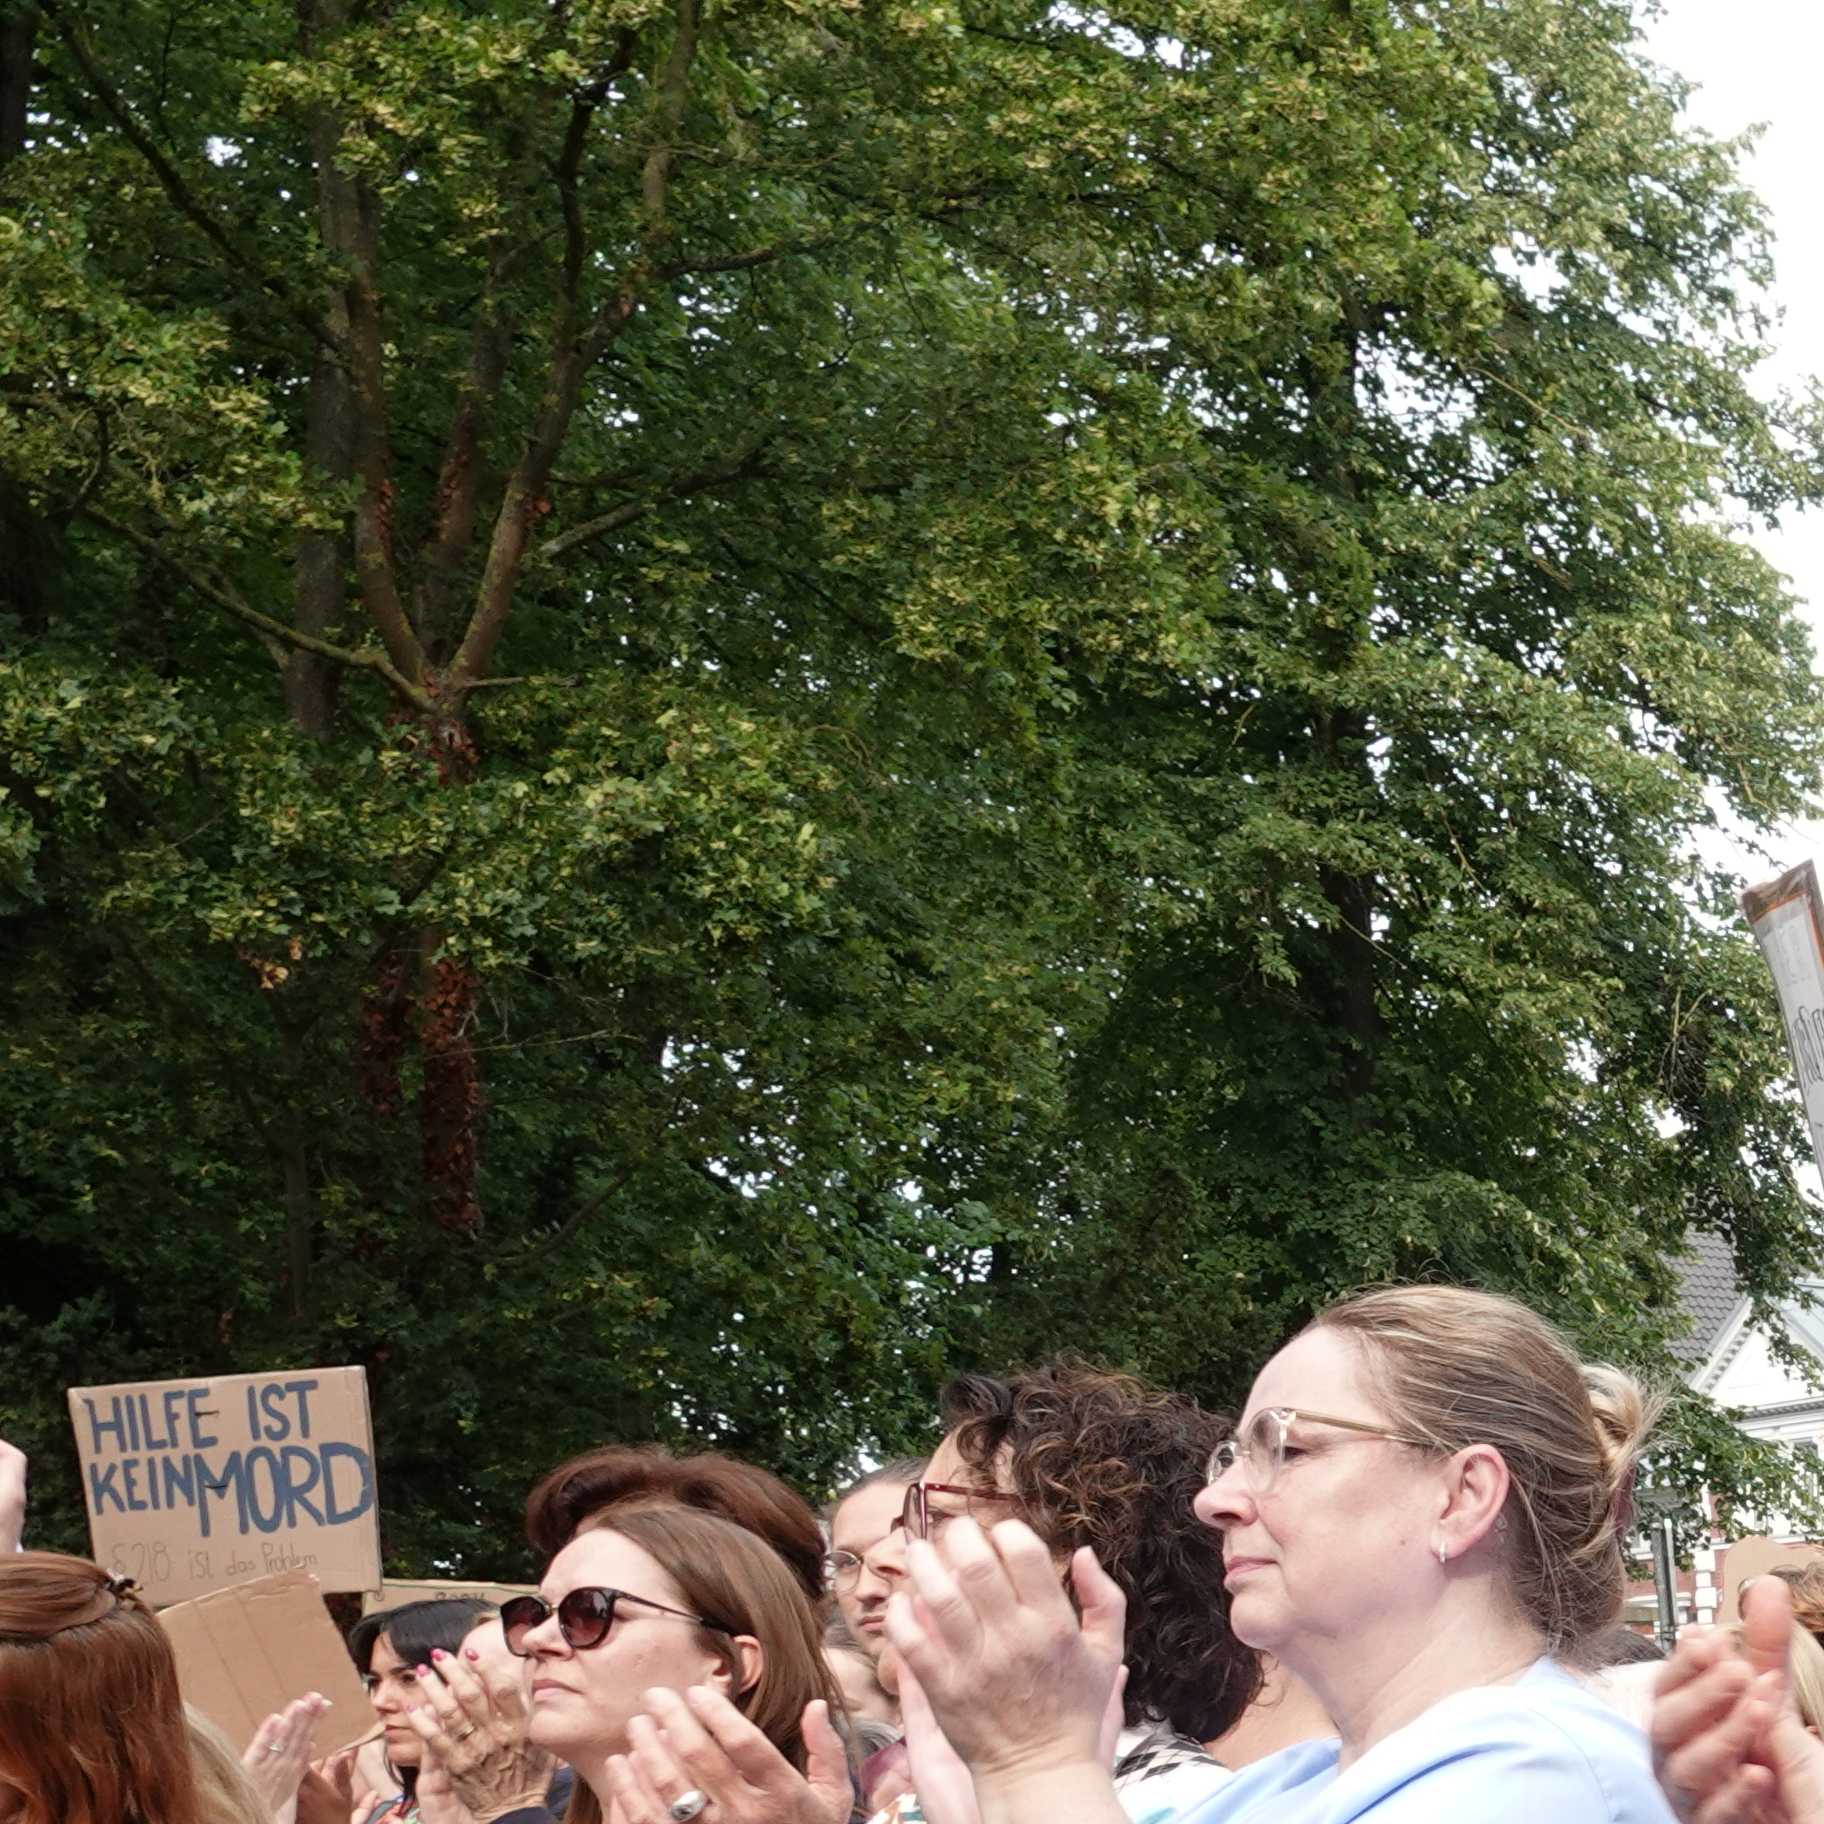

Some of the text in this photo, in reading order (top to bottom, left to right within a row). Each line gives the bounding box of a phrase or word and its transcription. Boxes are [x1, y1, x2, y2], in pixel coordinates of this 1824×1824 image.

[82, 1379, 319, 1455] HILFE IST
[227, 1552, 257, 1578] das
